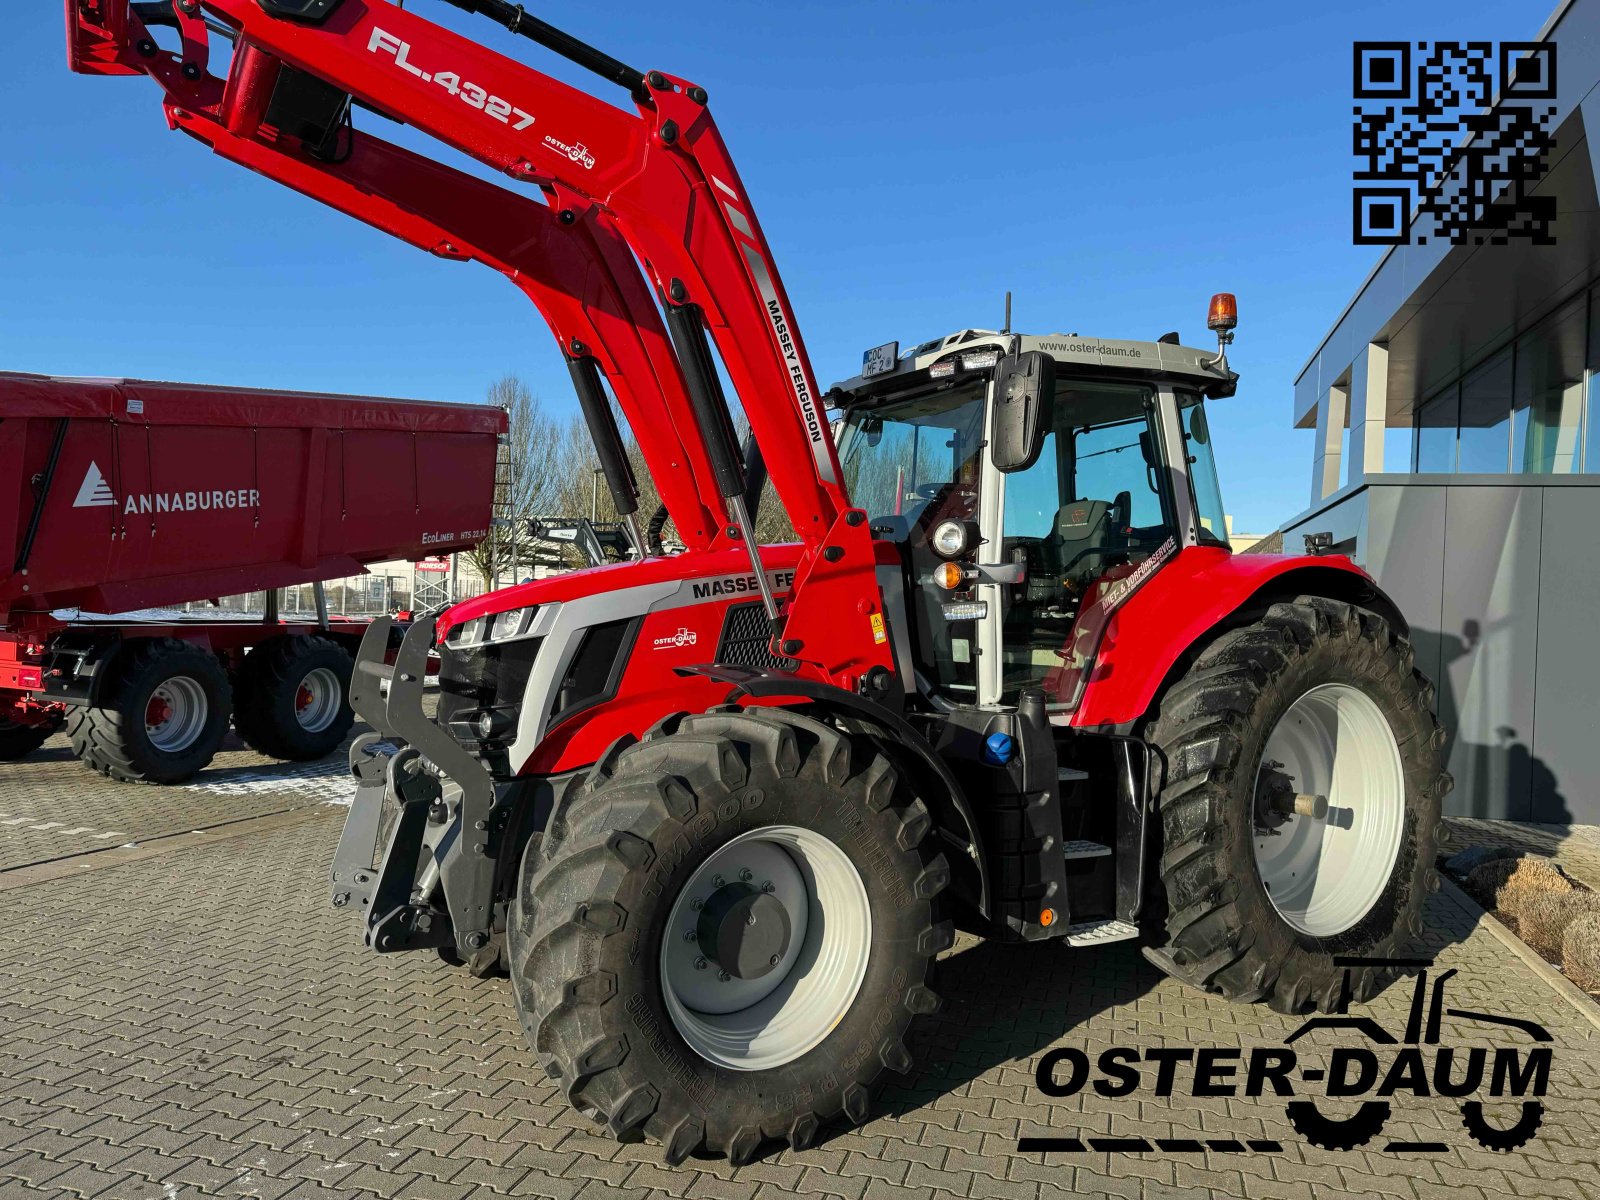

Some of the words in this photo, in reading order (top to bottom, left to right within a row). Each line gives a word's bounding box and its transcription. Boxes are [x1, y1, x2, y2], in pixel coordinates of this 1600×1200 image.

[545, 135, 594, 166] OSTER-DAUM
[1039, 342, 1141, 357] www.oster-daum.de
[767, 299, 797, 361] MASSEY
[790, 364, 822, 443] FERGUSON
[124, 489, 260, 515] ANNABURGER
[1126, 535, 1175, 587] VORFÜHRSERVICE
[692, 574, 769, 599] MASSE
[654, 634, 696, 645] OSTER-DAUM
[624, 992, 716, 1113] TRELLEBORG
